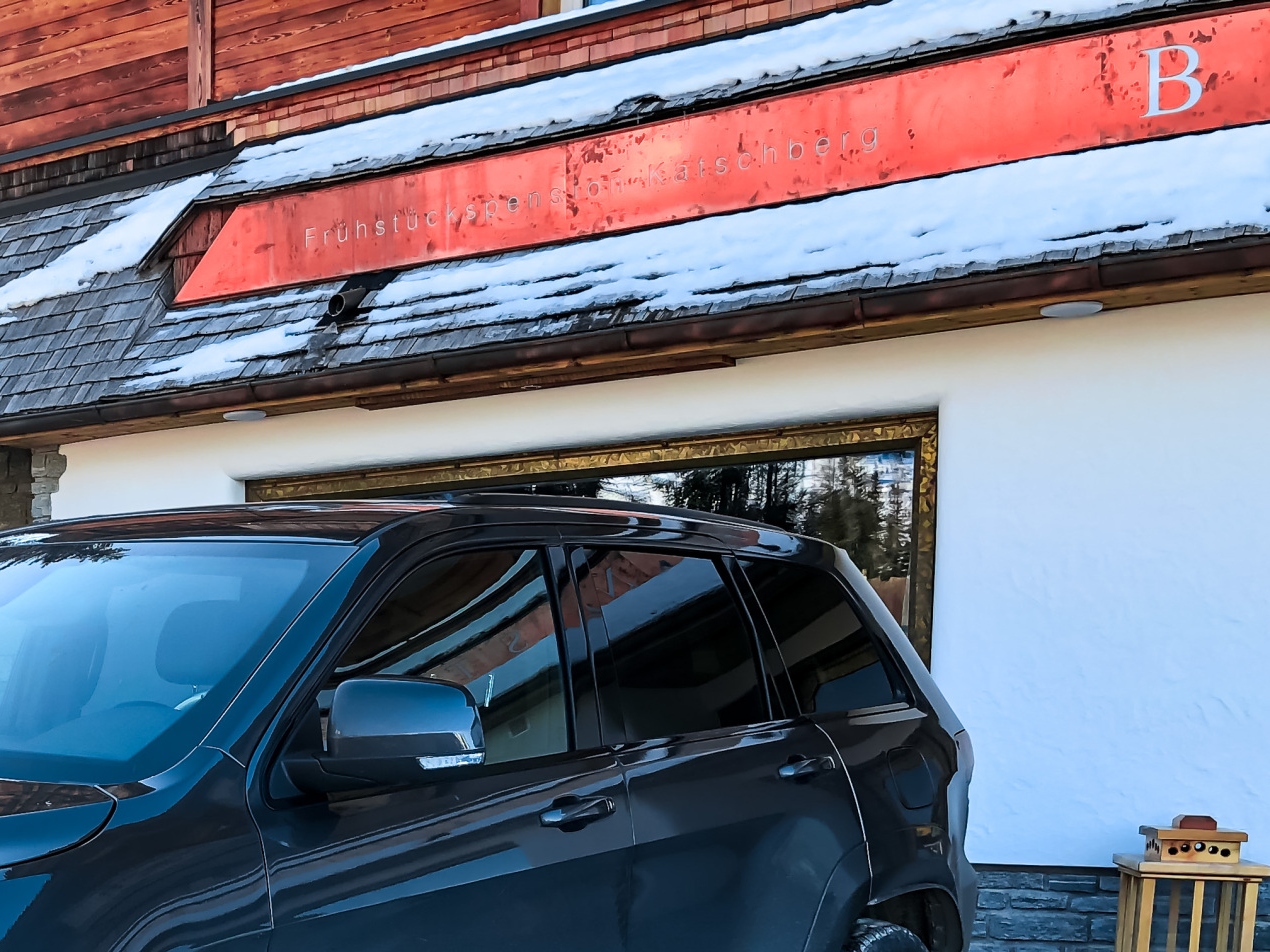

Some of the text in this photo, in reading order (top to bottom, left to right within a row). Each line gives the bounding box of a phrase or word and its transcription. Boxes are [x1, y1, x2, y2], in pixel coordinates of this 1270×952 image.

[1139, 44, 1203, 118] B
[304, 123, 879, 249] Frühstückspension Katschberg
